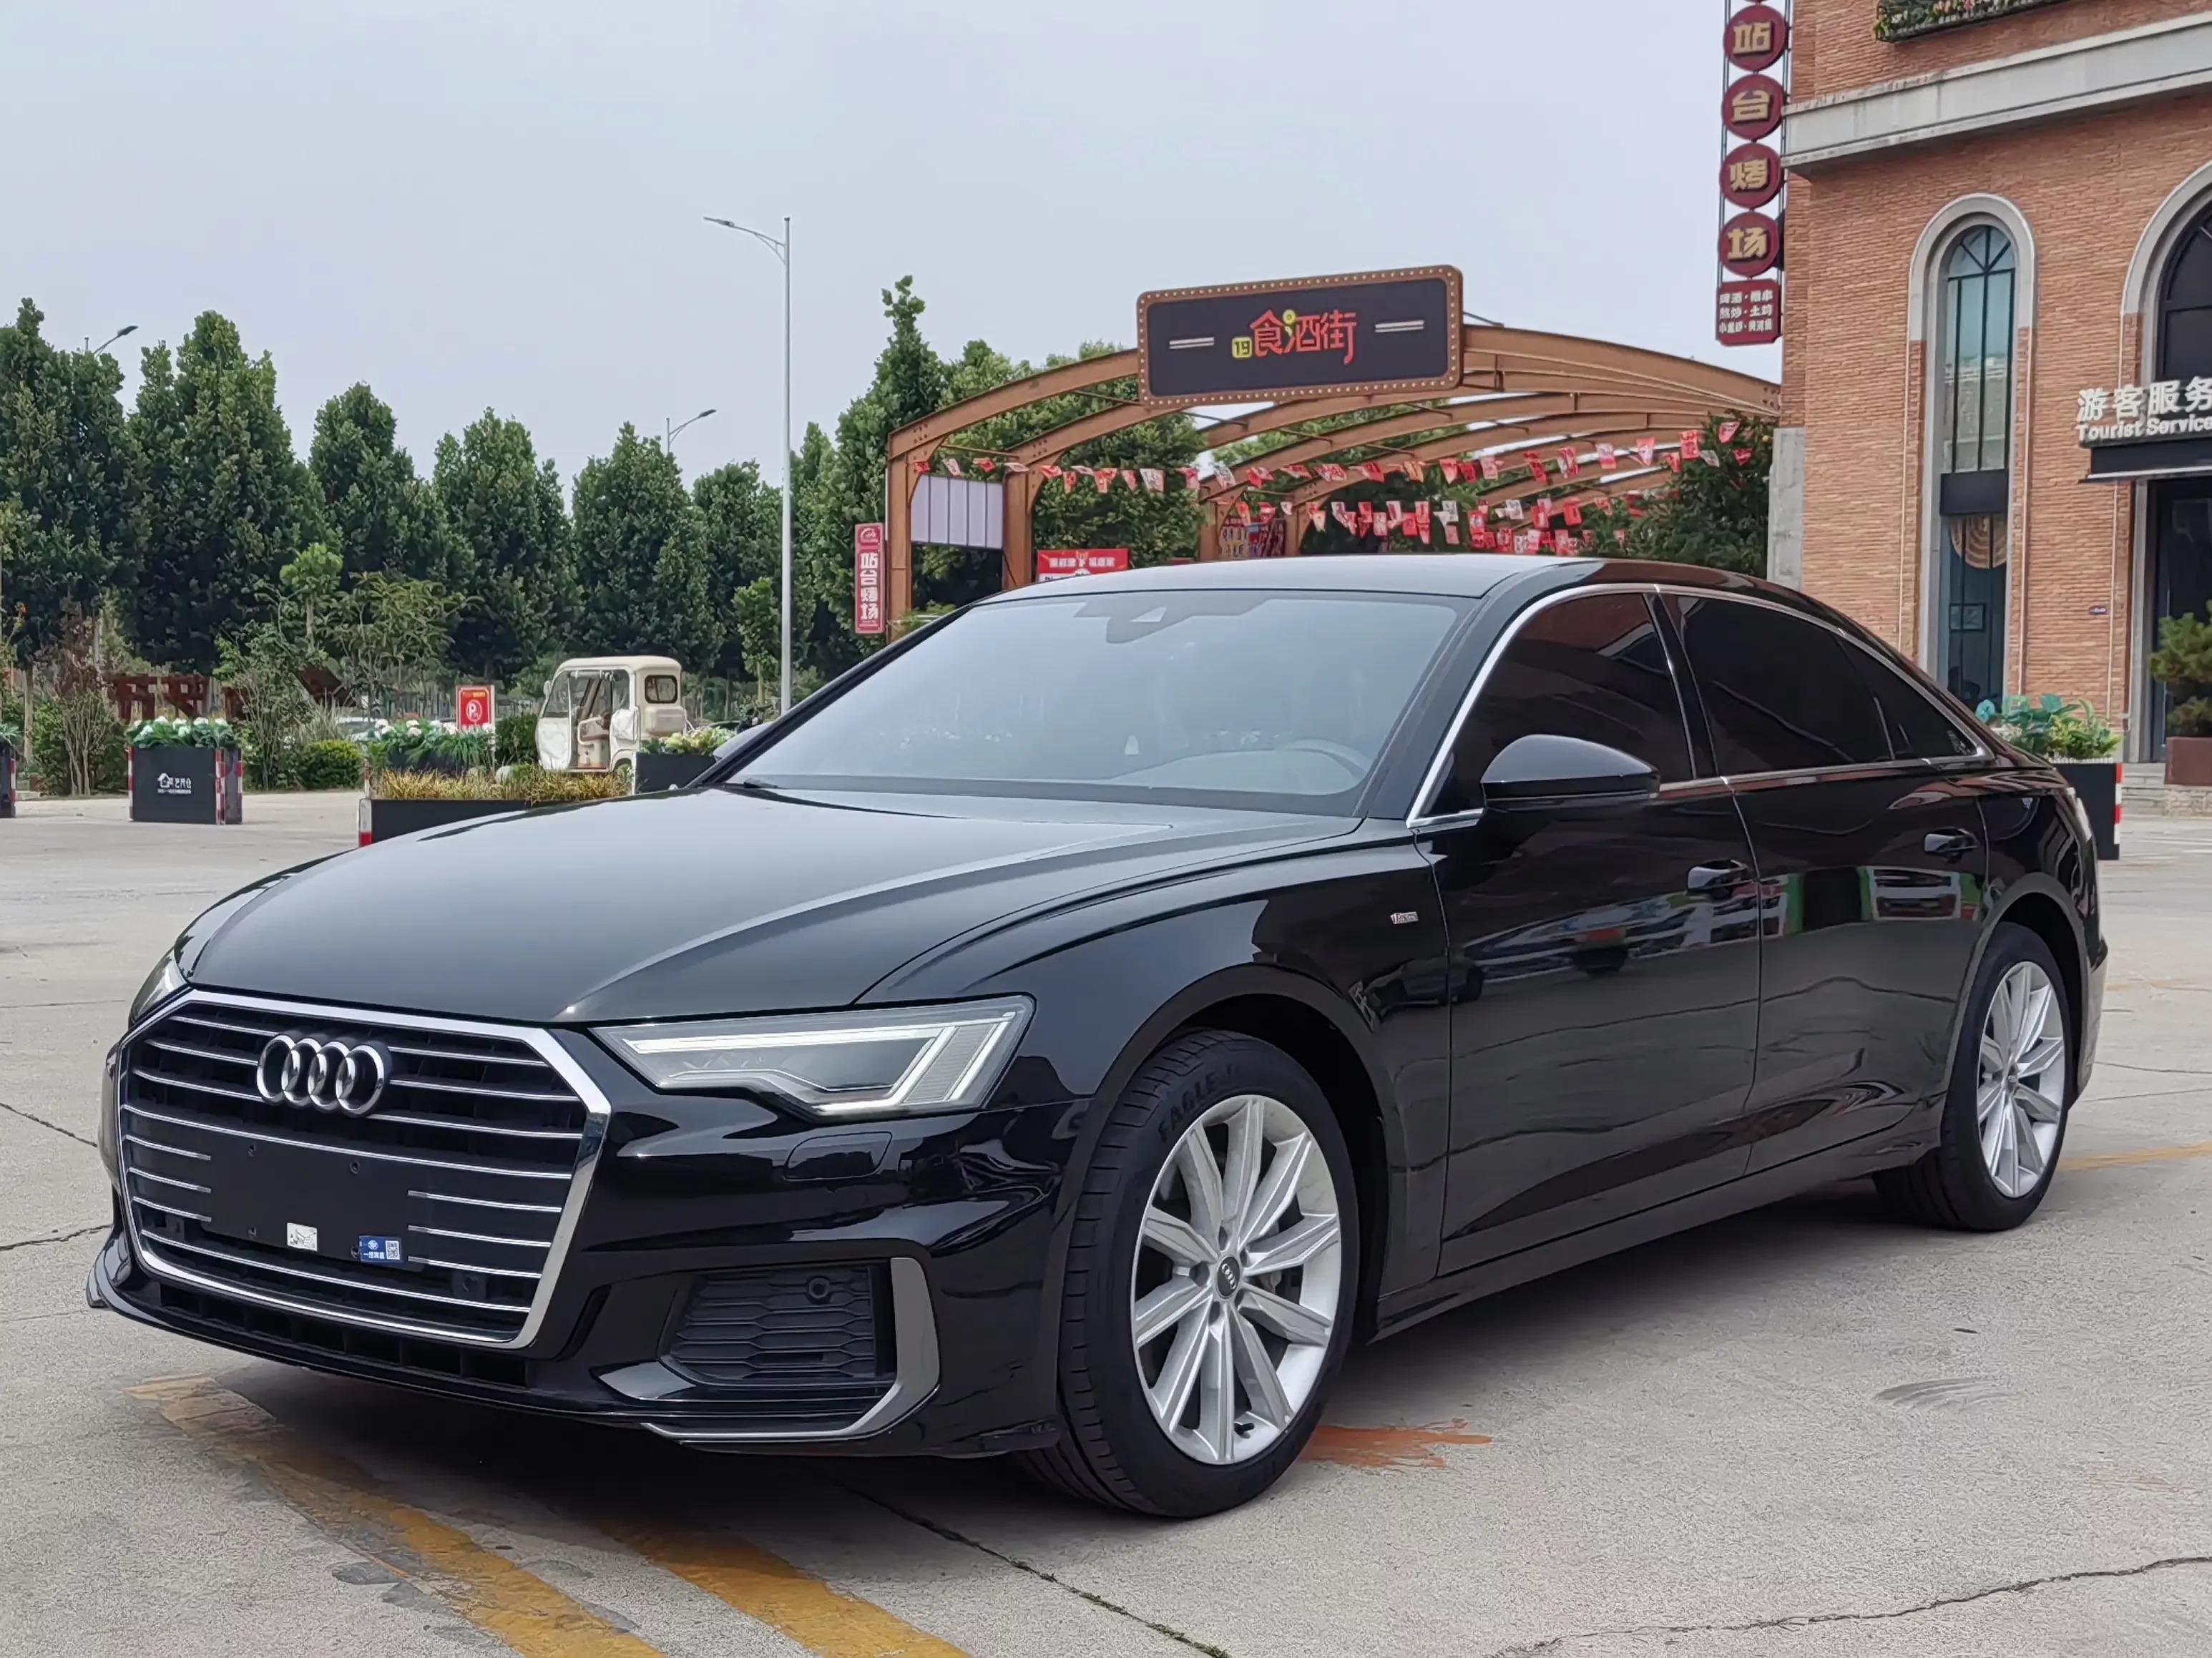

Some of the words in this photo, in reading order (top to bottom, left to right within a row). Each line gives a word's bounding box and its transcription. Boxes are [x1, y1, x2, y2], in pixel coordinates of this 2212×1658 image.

[1728, 22, 1771, 260] 站台烤场
[1250, 309, 1356, 365] 食酒街
[2076, 376, 2212, 422] 游客服务
[2076, 421, 2143, 441] Tourist
[2146, 413, 2212, 436] Service
